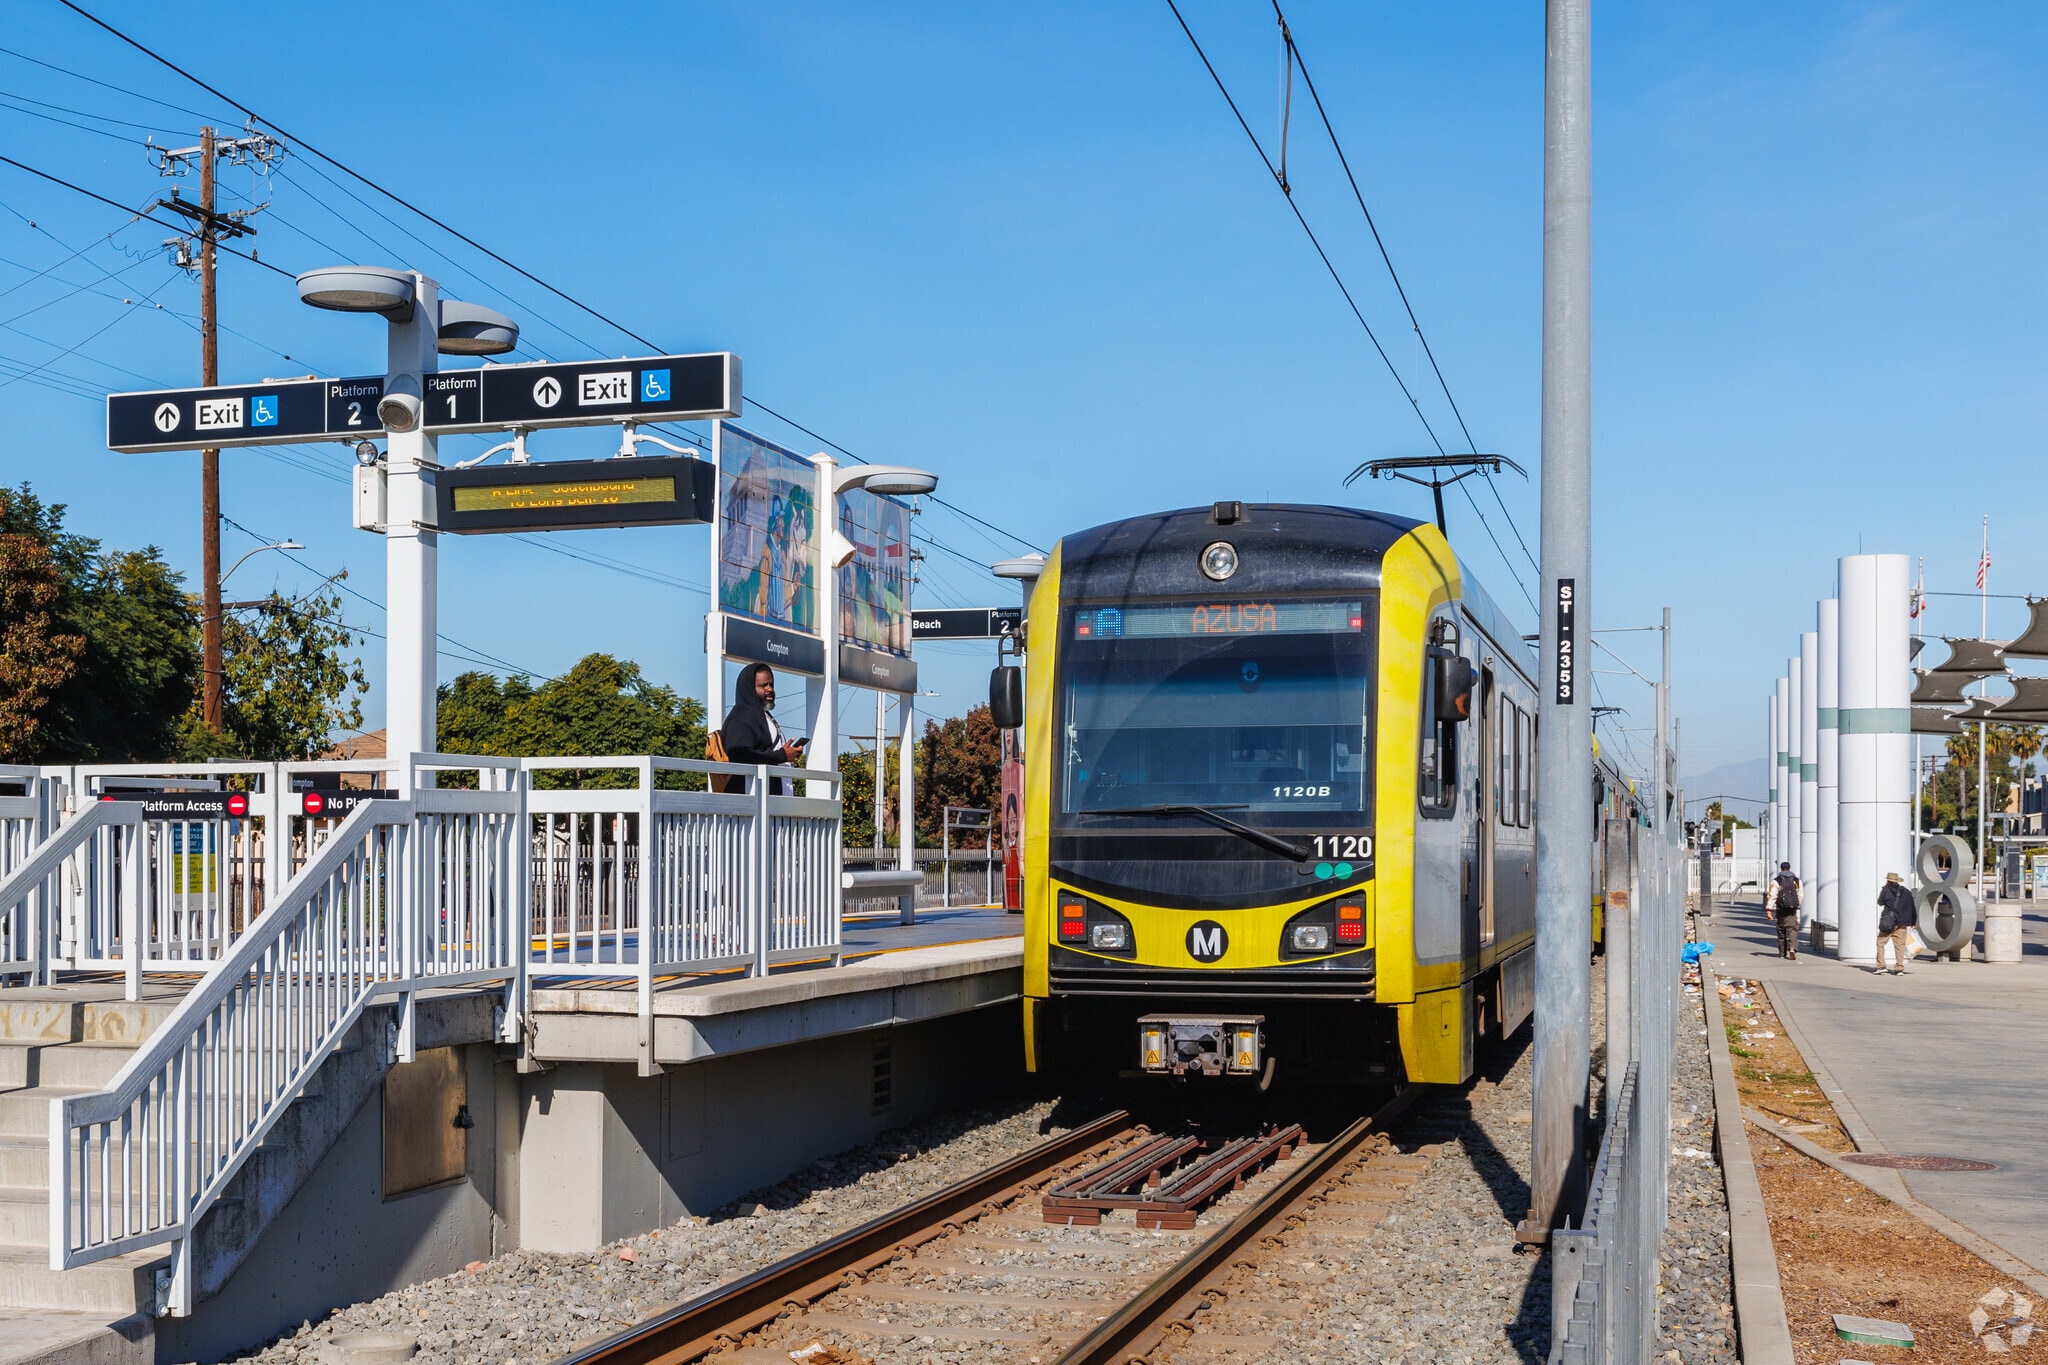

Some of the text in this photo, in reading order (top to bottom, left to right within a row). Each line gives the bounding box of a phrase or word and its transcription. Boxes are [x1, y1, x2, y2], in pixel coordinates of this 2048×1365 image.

[428, 377, 477, 390] Platform
[583, 378, 627, 401] Exit
[331, 386, 379, 398] Platform
[347, 402, 361, 426] 2
[446, 394, 456, 419] 1
[199, 404, 240, 425] Exit
[912, 620, 941, 629] Beach
[1096, 602, 1276, 636] A AZUSA
[1000, 620, 1010, 634] 2
[766, 639, 789, 657] Compton
[871, 663, 890, 678] Compton
[292, 778, 314, 790] ompton
[1272, 786, 1331, 797] 1120B
[186, 800, 223, 812] Access
[328, 797, 343, 809] No
[1313, 836, 1372, 858] 1120
[1193, 927, 1221, 956] M
